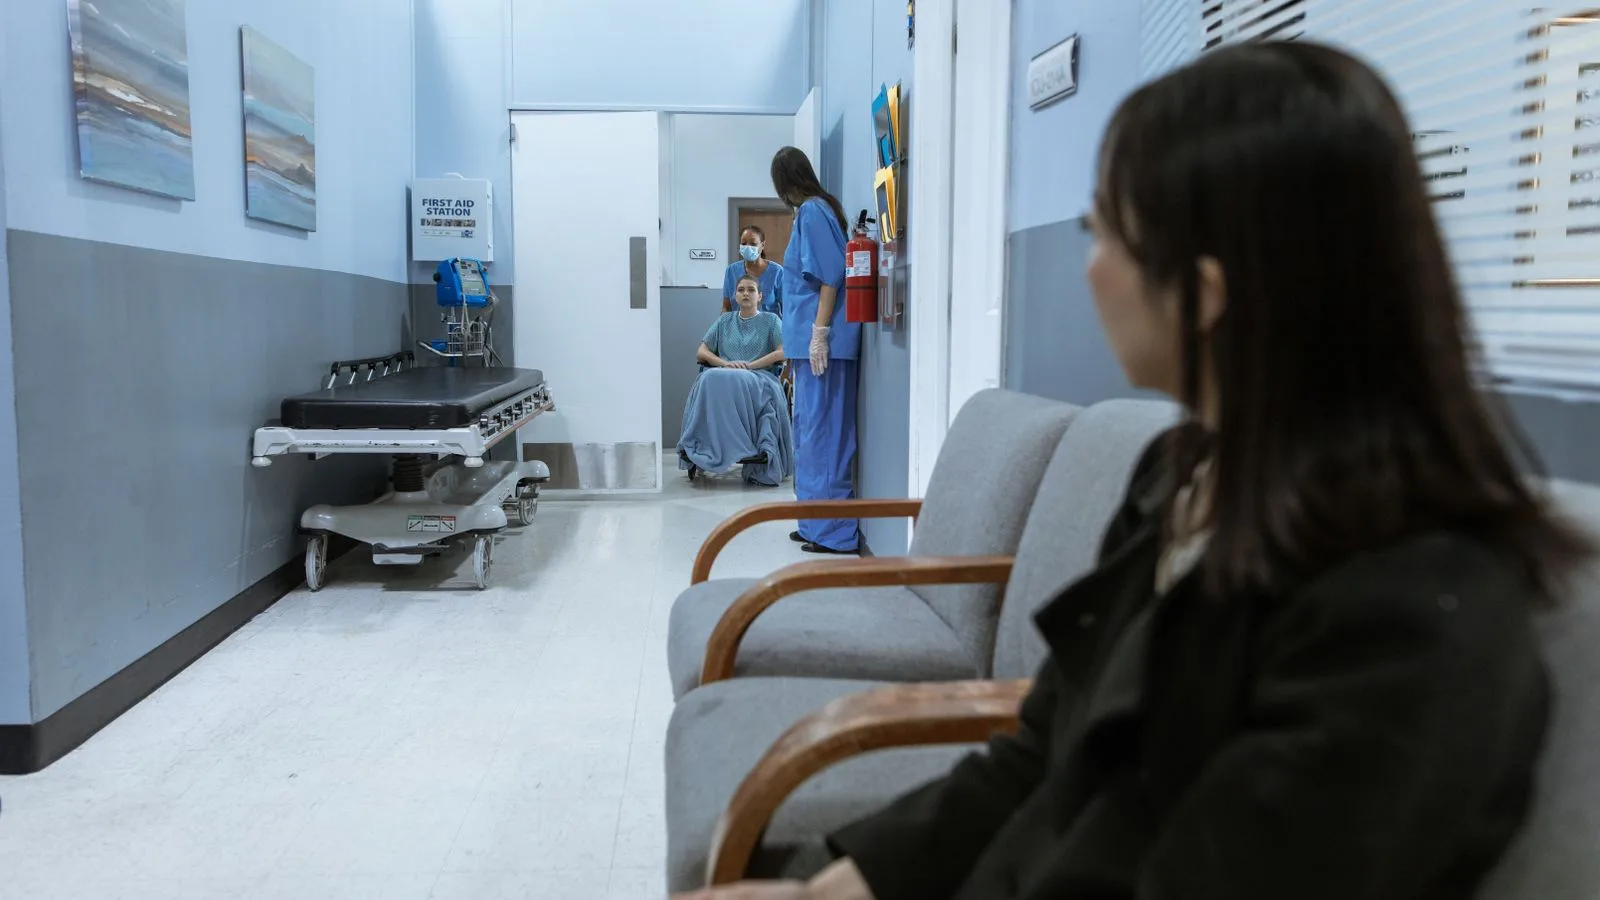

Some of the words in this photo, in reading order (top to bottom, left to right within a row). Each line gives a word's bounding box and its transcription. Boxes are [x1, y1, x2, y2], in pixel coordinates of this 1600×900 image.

[422, 198, 453, 207] FIRST
[455, 199, 475, 208] AID
[426, 207, 471, 216] STATION
